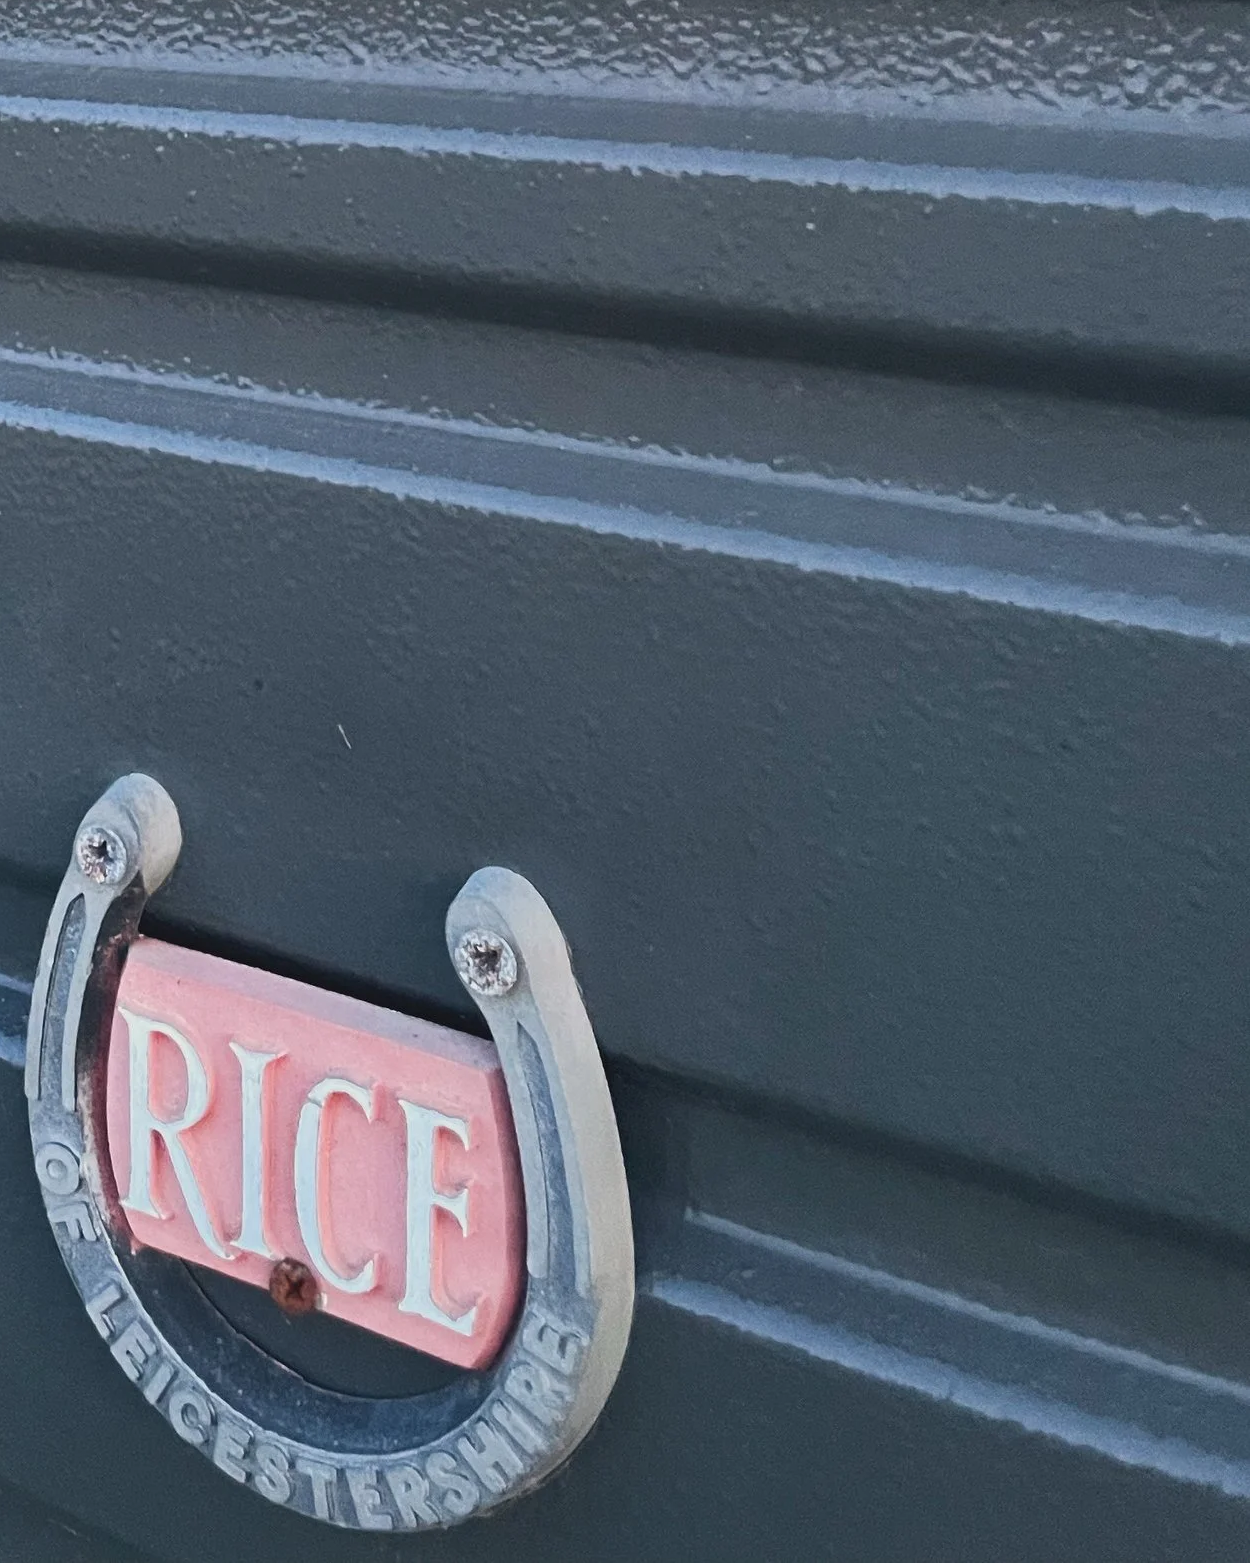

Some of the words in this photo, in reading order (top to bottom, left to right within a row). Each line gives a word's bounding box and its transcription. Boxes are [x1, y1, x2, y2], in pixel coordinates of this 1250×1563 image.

[36, 1142, 100, 1242] OF
[86, 1278, 590, 1530] LEICESTERSHIRE
[118, 1006, 478, 1337] RICE
